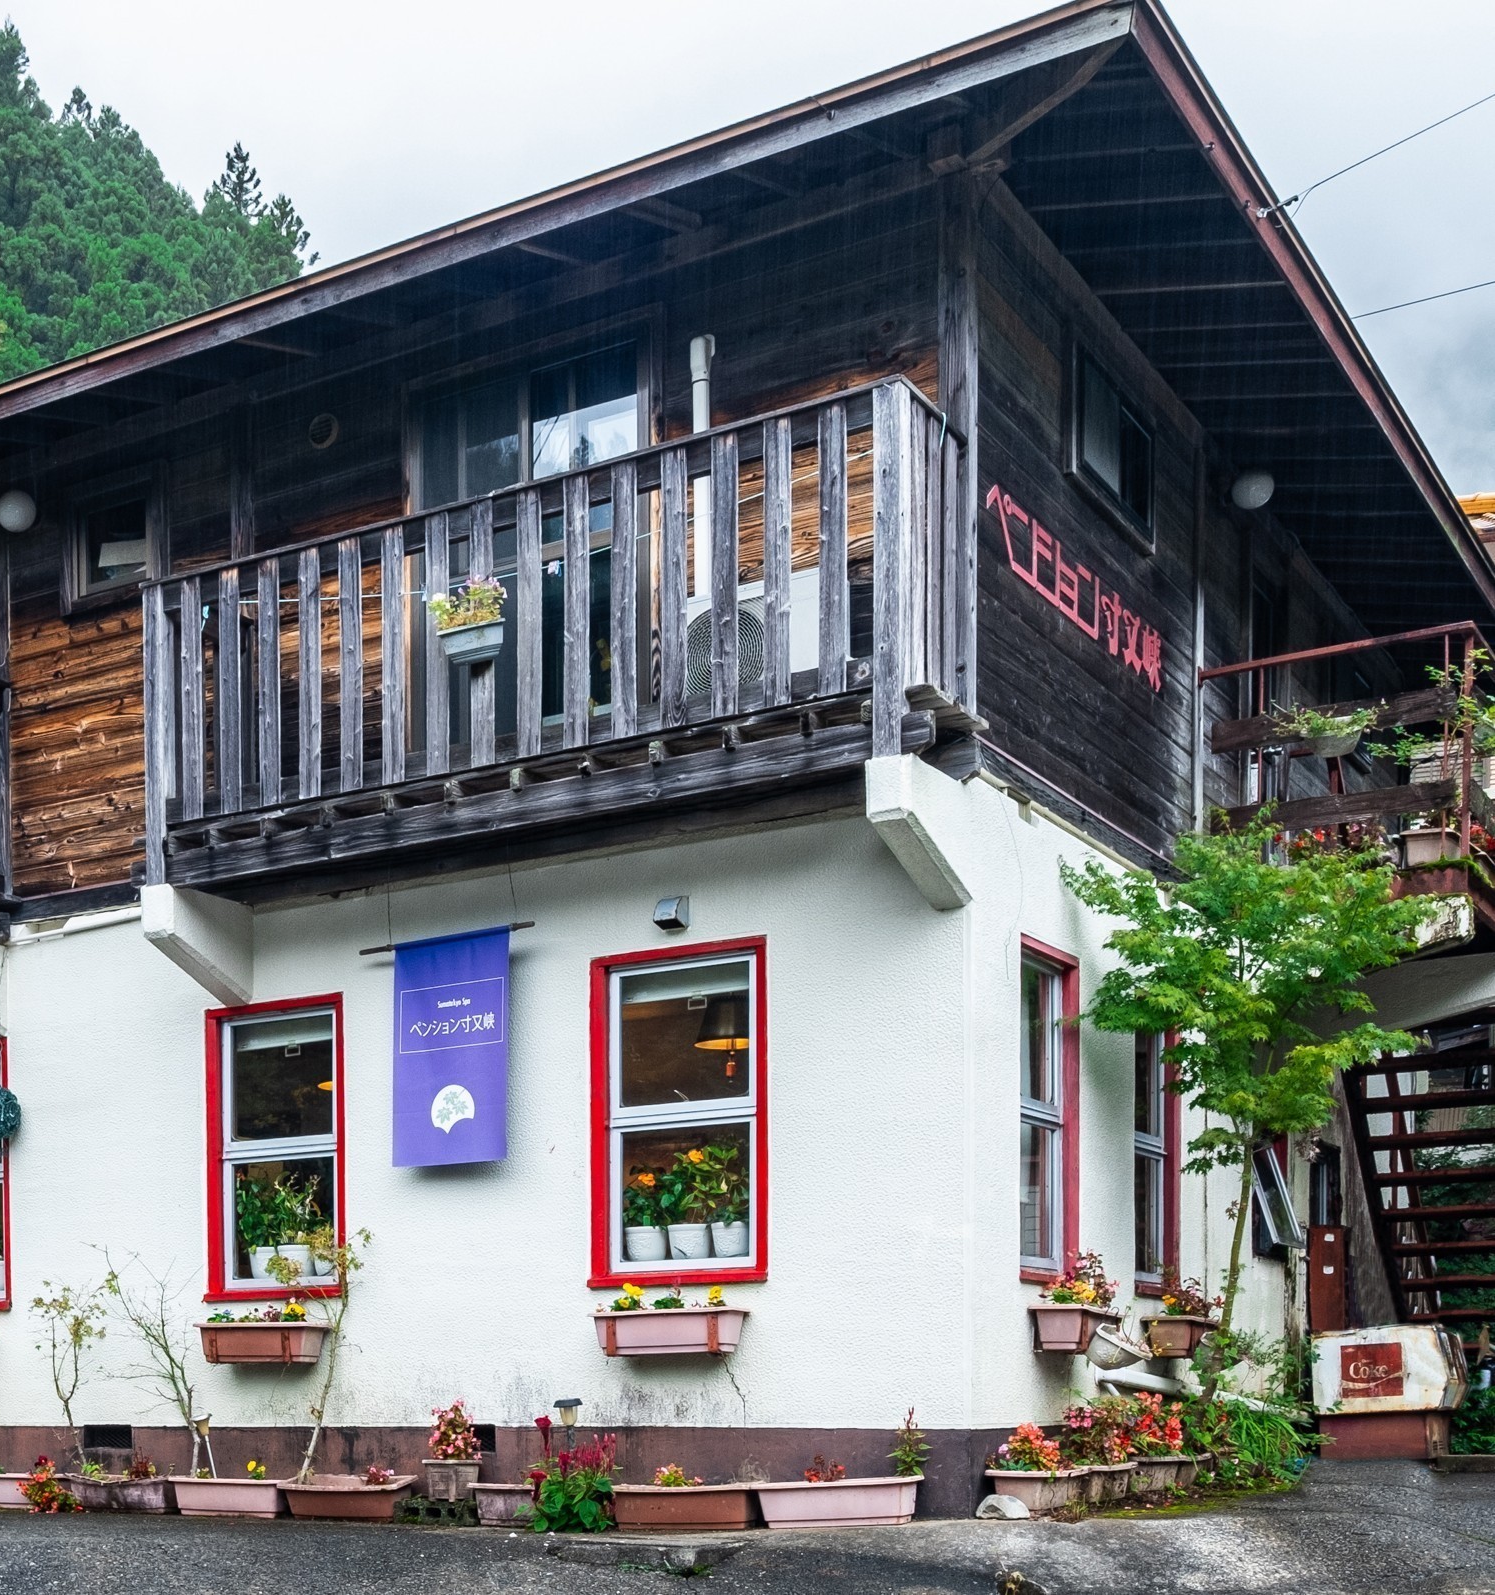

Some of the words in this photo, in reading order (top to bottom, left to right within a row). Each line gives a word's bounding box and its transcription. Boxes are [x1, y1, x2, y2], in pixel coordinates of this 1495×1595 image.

[409, 1011, 495, 1037] ペンション寸又峡
[1349, 1361, 1388, 1378] Coke
